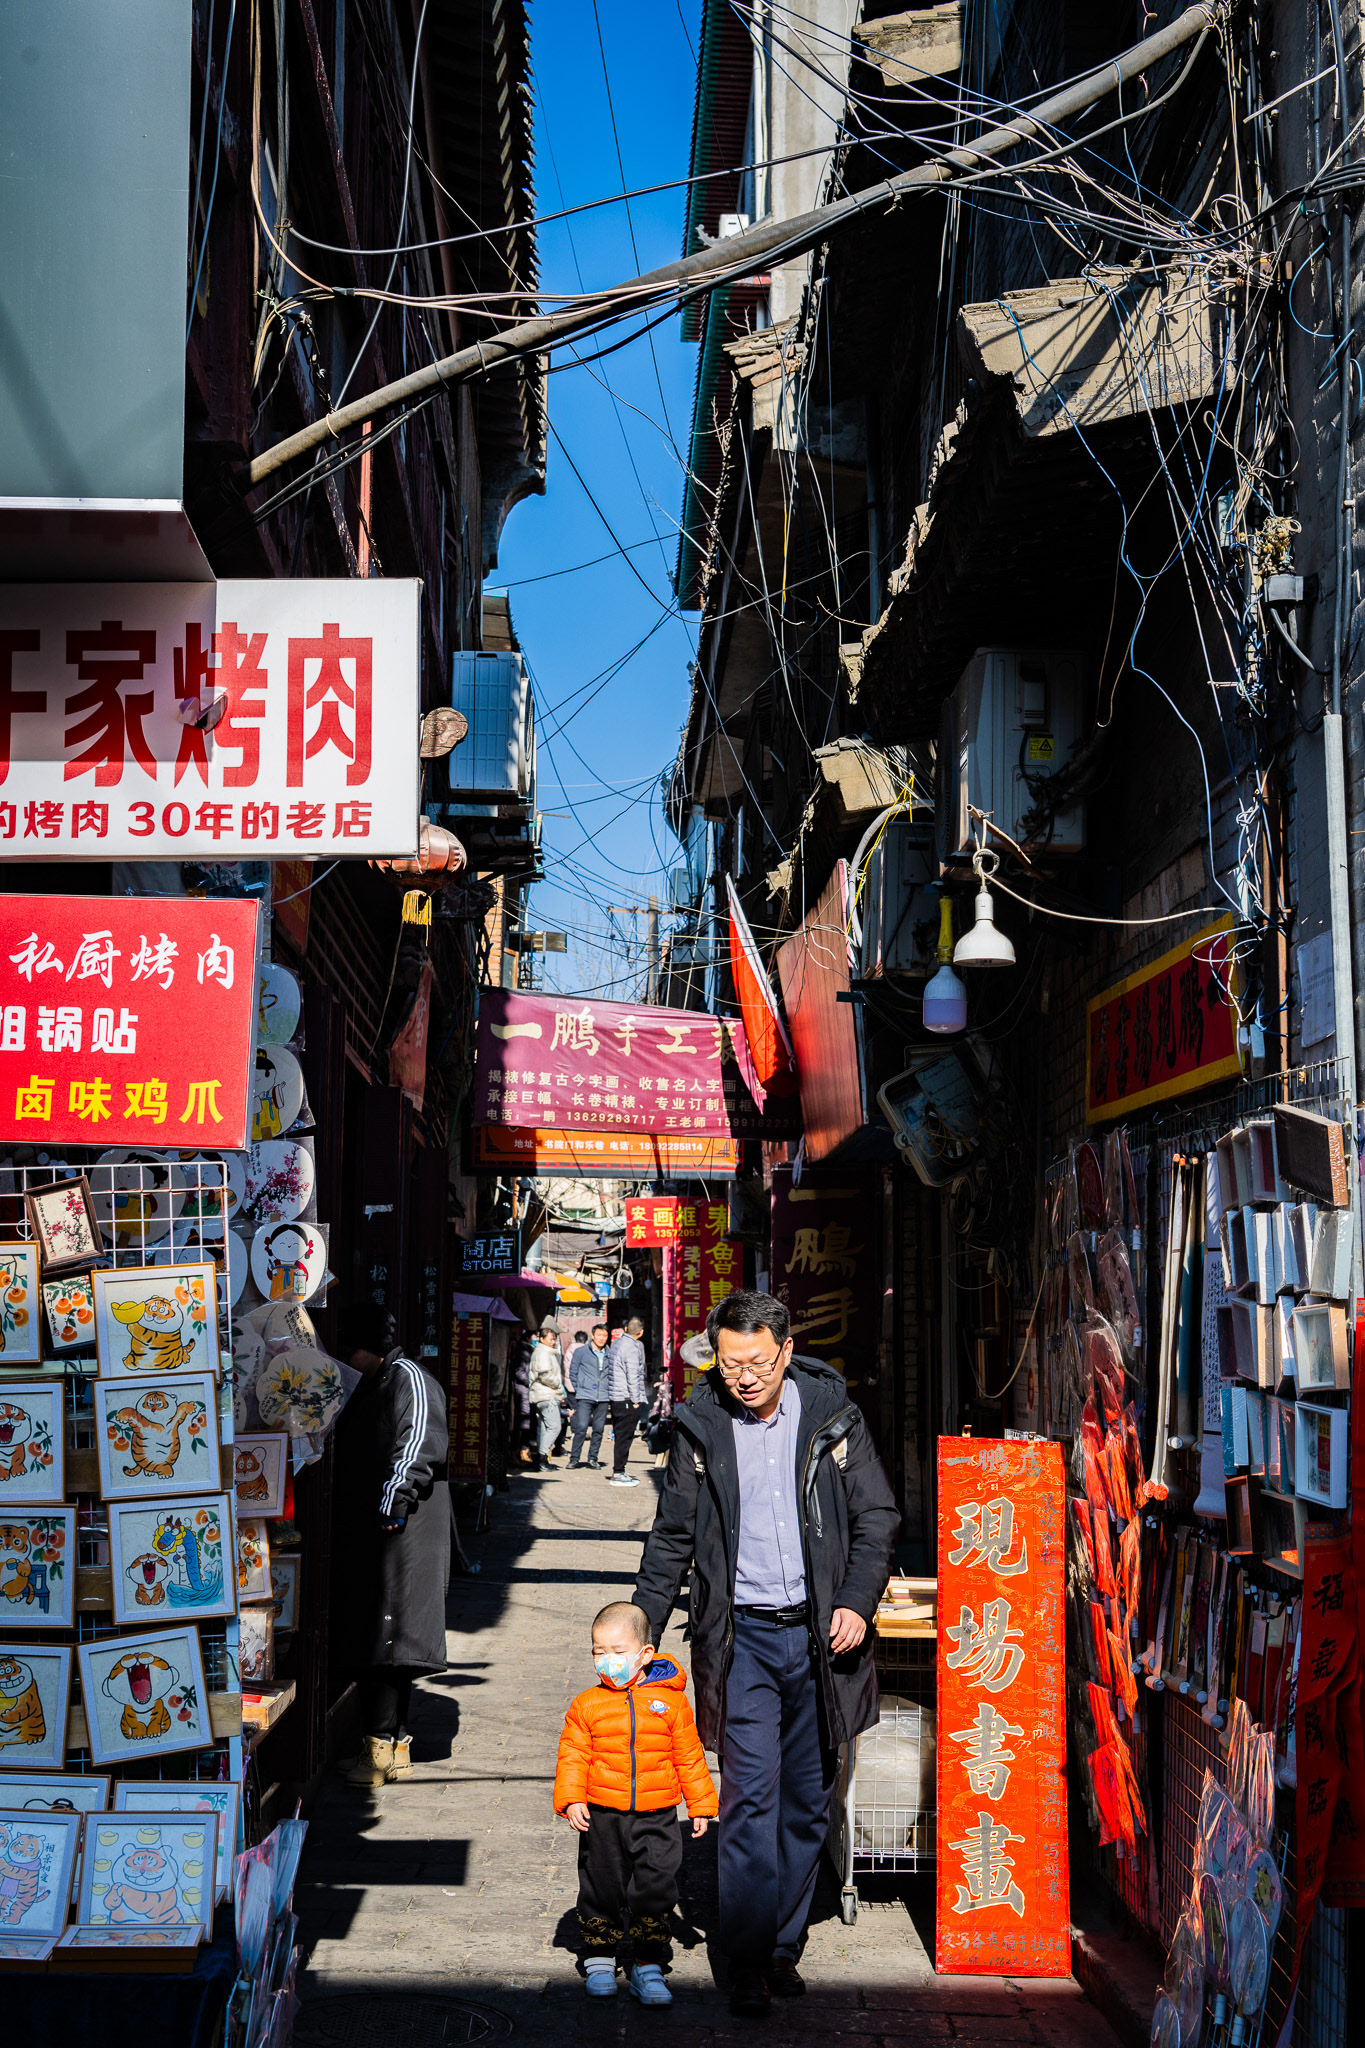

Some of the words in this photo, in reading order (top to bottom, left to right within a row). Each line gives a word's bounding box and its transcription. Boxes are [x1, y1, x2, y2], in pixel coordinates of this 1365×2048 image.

[127, 800, 371, 840] 30年的老店
[8, 930, 235, 990] 私厨烤肉
[490, 1006, 751, 1066] 一鹏手工装
[15, 1074, 224, 1125] 卤味鸡爪
[566, 1111, 656, 1126] 13629283717
[665, 1114, 706, 1129] 王老师
[631, 1206, 647, 1240] 安东
[653, 1206, 697, 1228] 画框
[462, 1258, 513, 1271] STORE
[463, 1317, 483, 1465] 手工机器装裱字画
[943, 1444, 1043, 1479] 一鹏店
